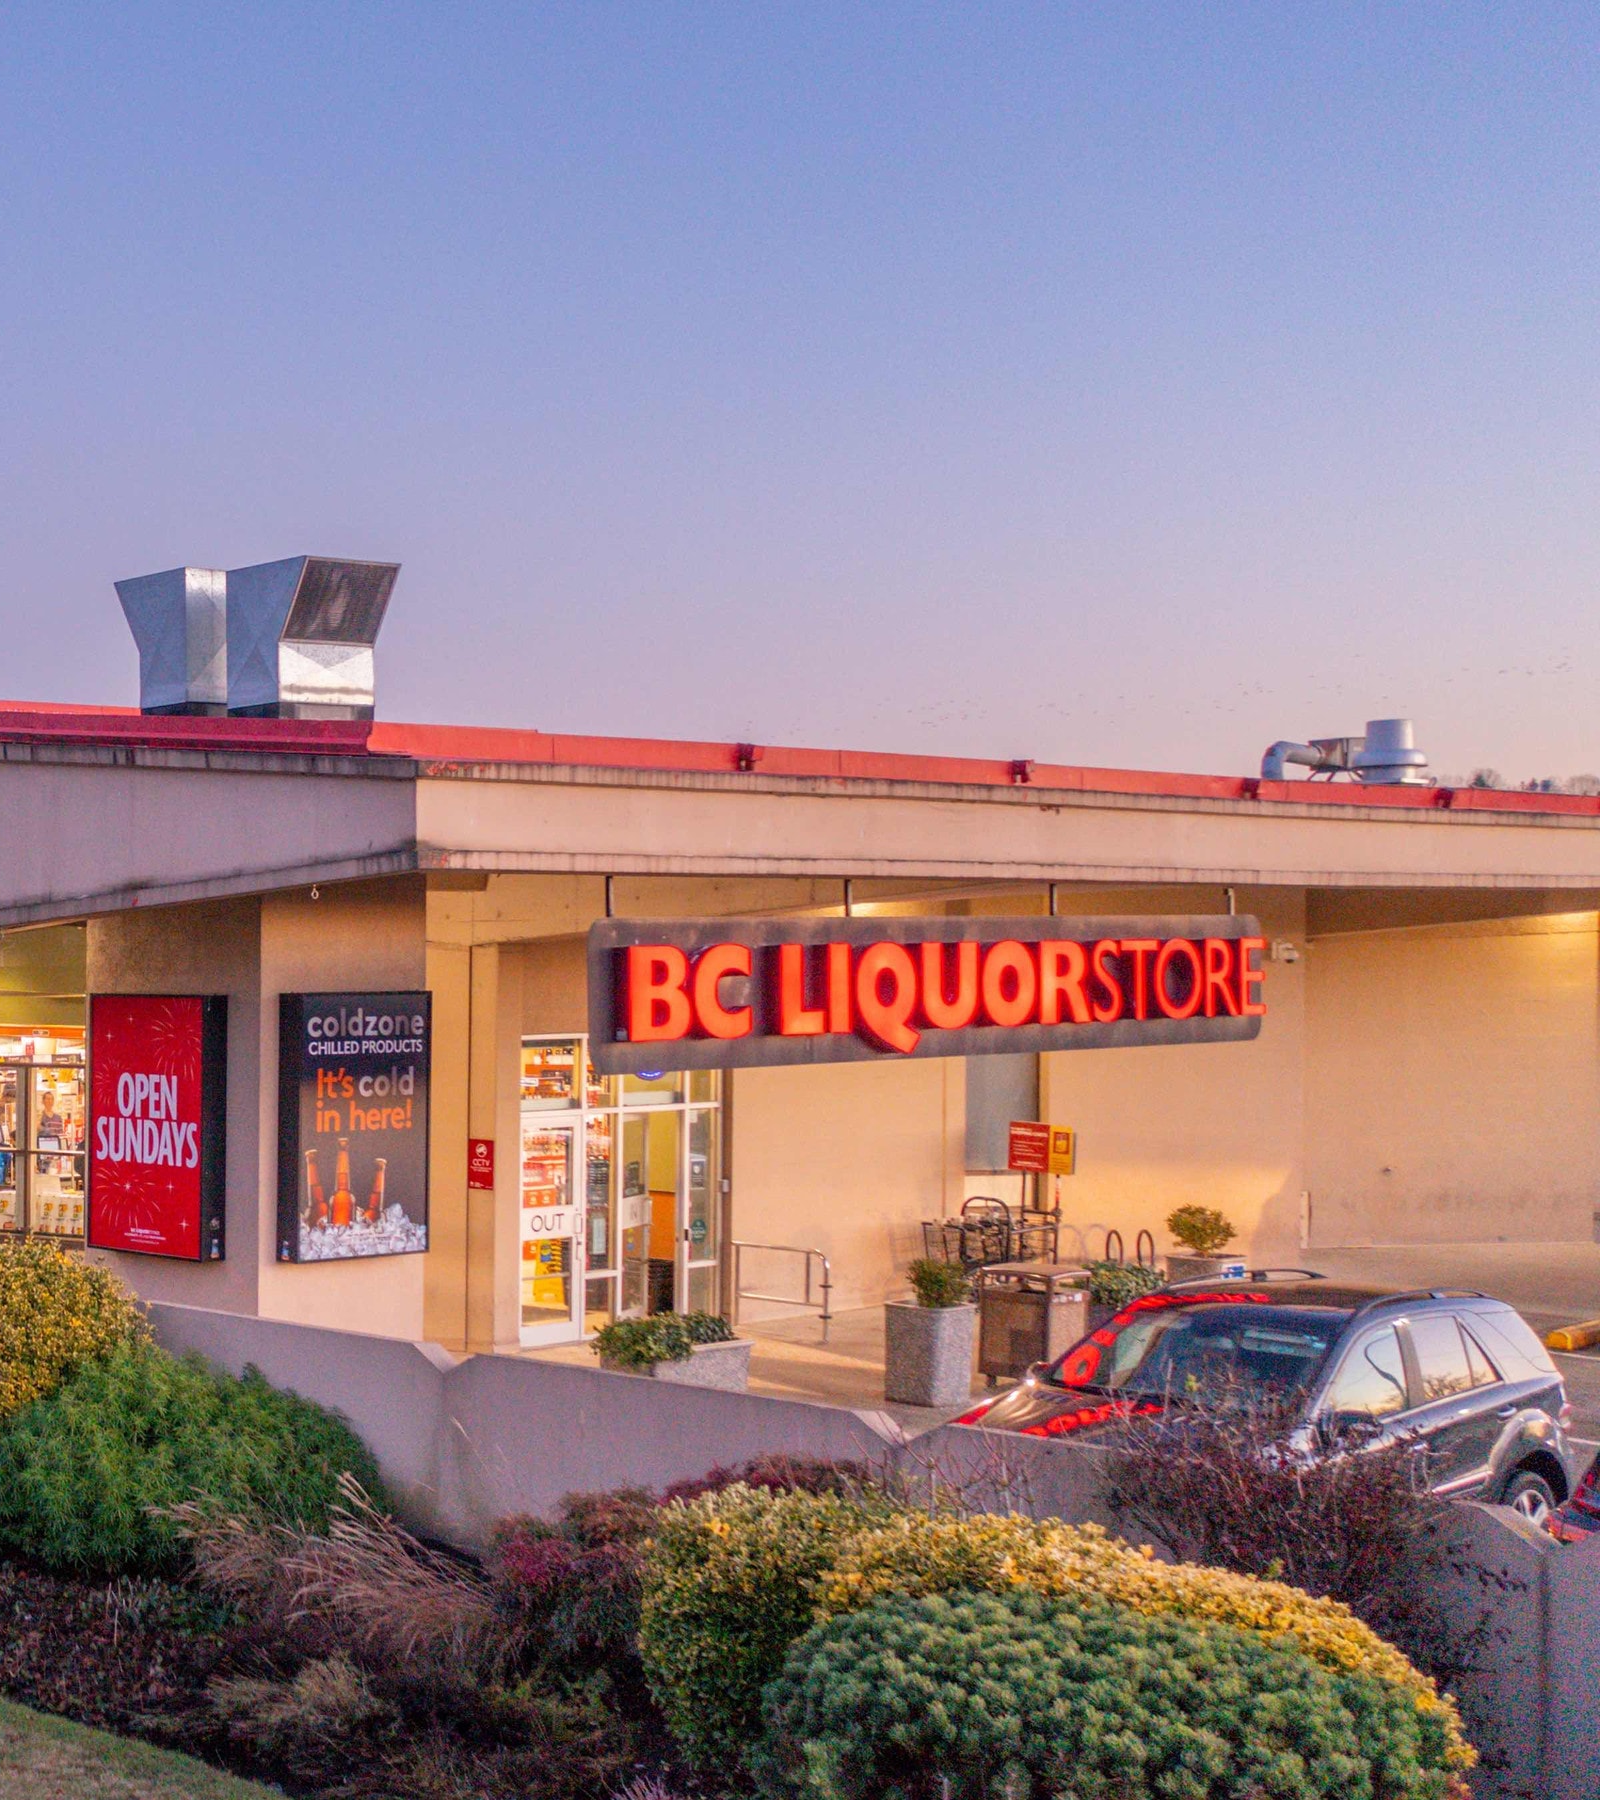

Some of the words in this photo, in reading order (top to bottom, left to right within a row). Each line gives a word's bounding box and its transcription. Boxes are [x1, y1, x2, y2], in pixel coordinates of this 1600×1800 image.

[626, 942, 754, 1043] BC
[307, 1008, 424, 1038] coldzone
[308, 1040, 359, 1056] CHILLED
[361, 1039, 423, 1054] PRODUCTS
[117, 1072, 177, 1120] OPEN
[358, 1065, 414, 1097] cold
[316, 1101, 340, 1133] in
[350, 1098, 413, 1131] here!
[96, 1117, 198, 1168] SUNDAYS
[531, 1213, 565, 1232] OUT
